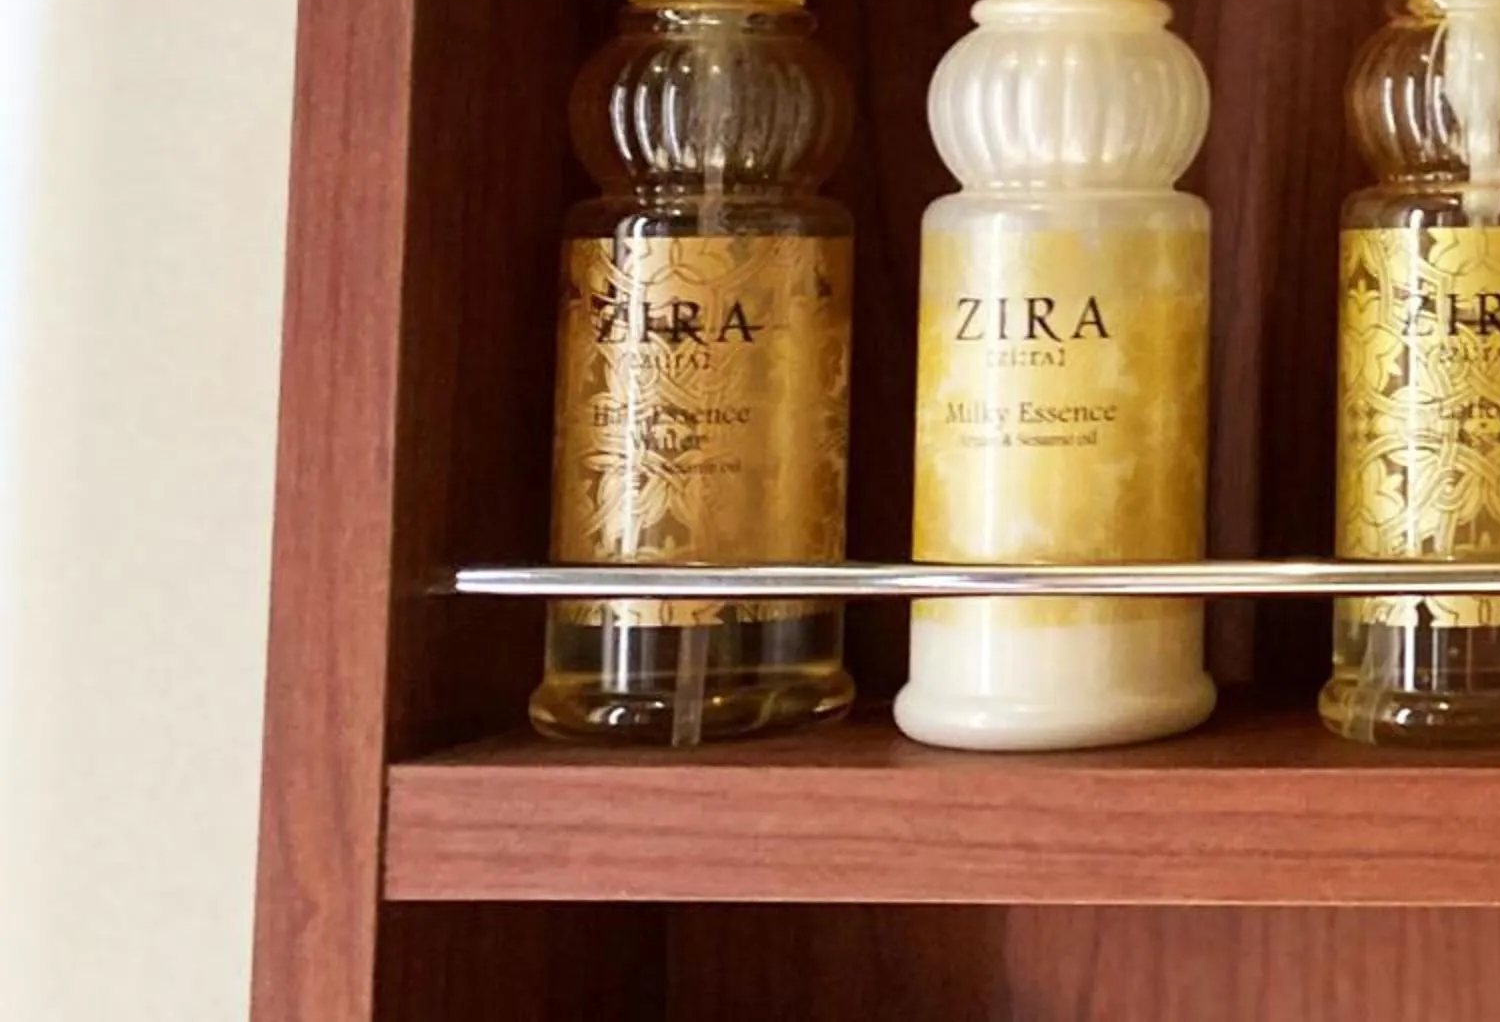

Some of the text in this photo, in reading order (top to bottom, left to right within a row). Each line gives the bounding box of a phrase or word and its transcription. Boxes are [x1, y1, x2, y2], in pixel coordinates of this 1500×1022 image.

[597, 298, 755, 346] ZIRA
[955, 295, 1109, 342] ZIRA
[945, 401, 1118, 431] Milky Essence
